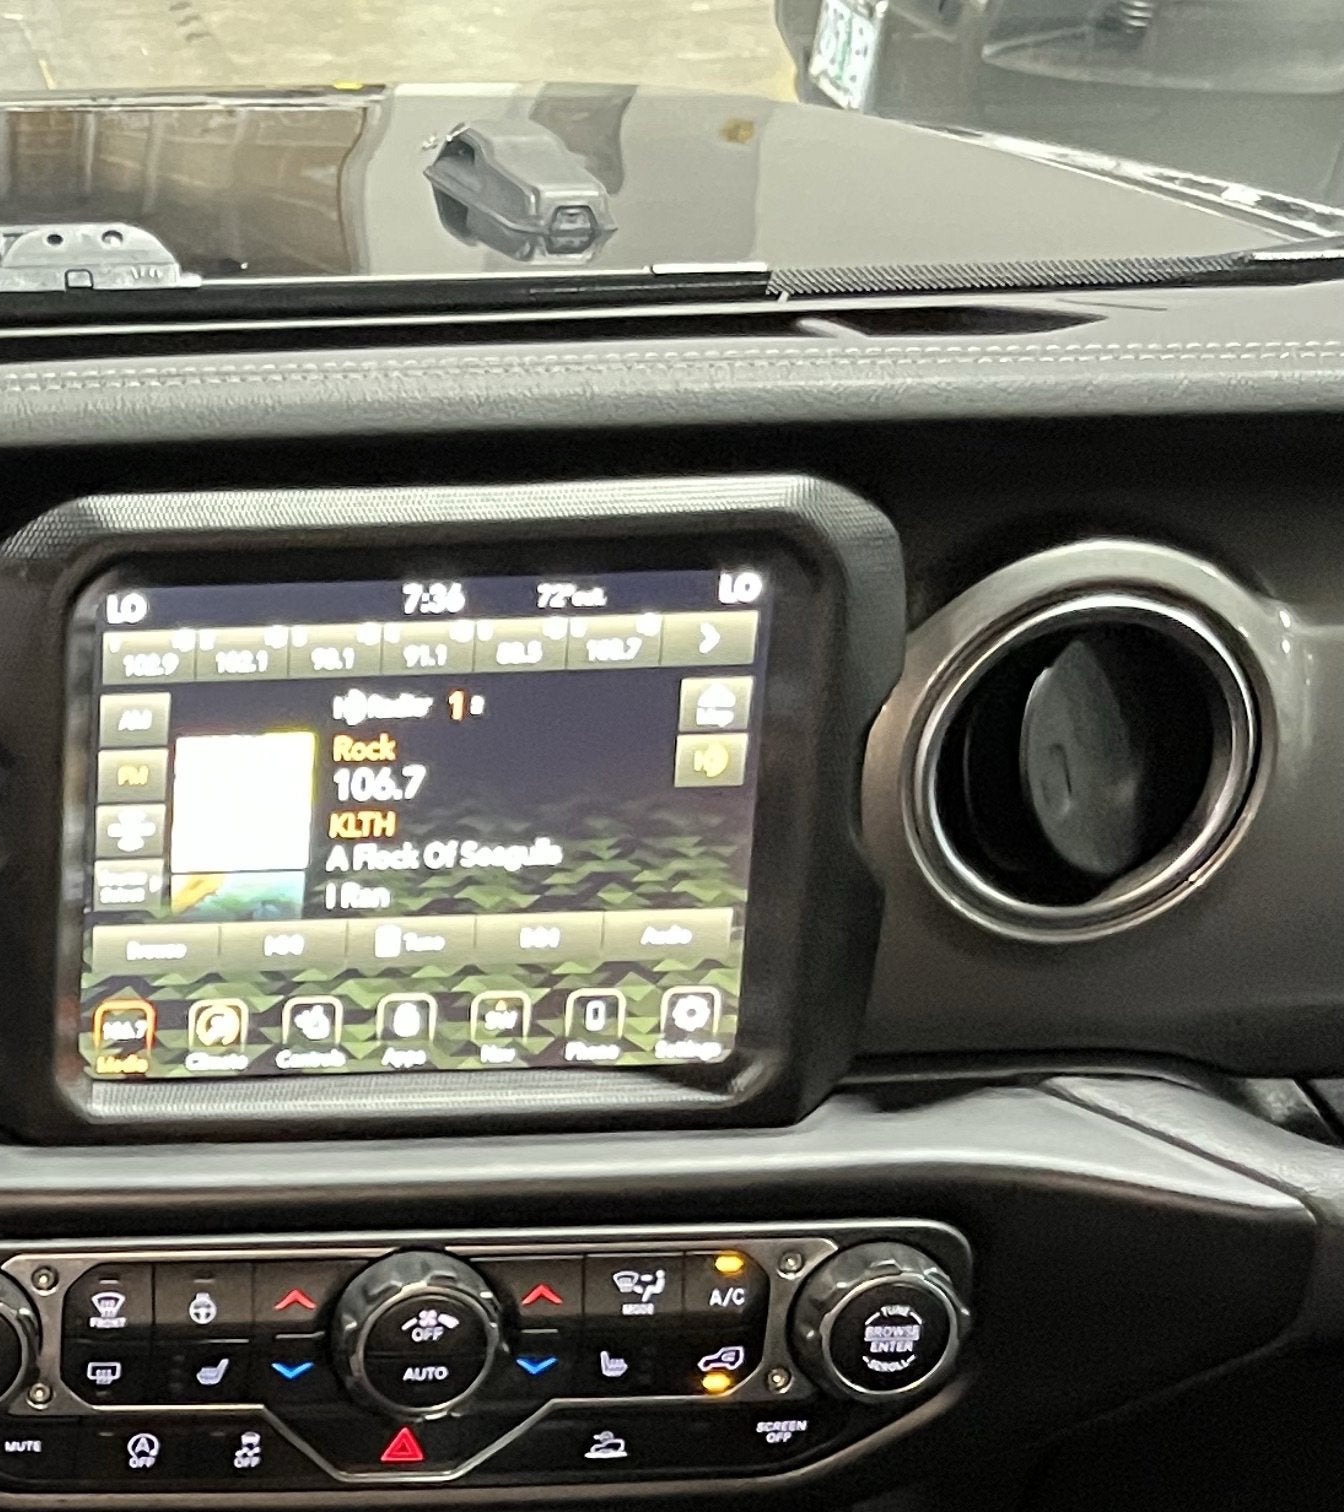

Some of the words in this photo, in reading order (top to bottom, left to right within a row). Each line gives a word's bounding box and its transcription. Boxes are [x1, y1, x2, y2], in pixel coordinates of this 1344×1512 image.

[718, 571, 763, 604] LO
[401, 581, 466, 614] 7:36
[107, 592, 148, 624] LO
[332, 732, 397, 763] Rock
[332, 763, 427, 802] 106.7
[328, 810, 397, 839] KLTH
[325, 844, 350, 872] A
[423, 839, 459, 870] Of
[709, 1287, 746, 1308] A/C
[411, 1325, 445, 1343] OFF
[864, 1324, 921, 1341] BROWSE
[869, 1340, 914, 1353] ENTER
[402, 1365, 450, 1382] AUTO
[756, 1419, 808, 1434] SCREEN
[4, 1440, 42, 1453] MUTE
[766, 1431, 793, 1444] OFF
[128, 1456, 156, 1469] OFF
[233, 1456, 261, 1469] OFF
